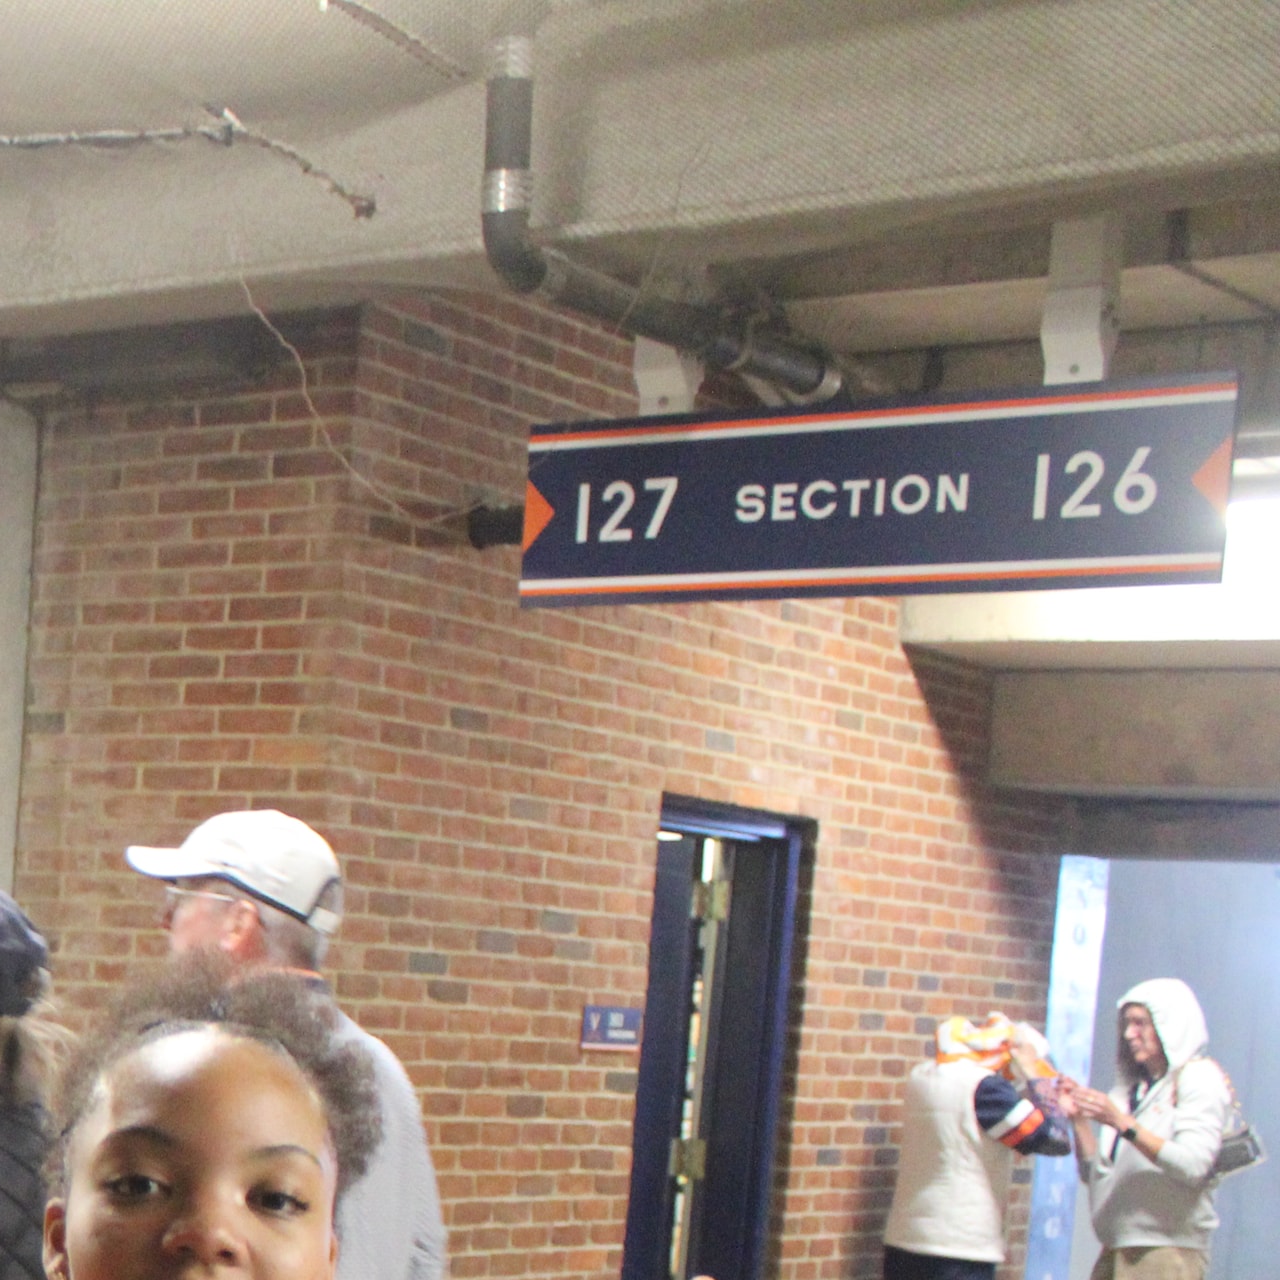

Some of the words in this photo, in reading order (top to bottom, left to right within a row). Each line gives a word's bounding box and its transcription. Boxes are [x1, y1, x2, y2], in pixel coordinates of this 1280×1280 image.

[575, 476, 678, 544] 127
[735, 473, 970, 522] SECTION
[1032, 446, 1158, 521] 126
